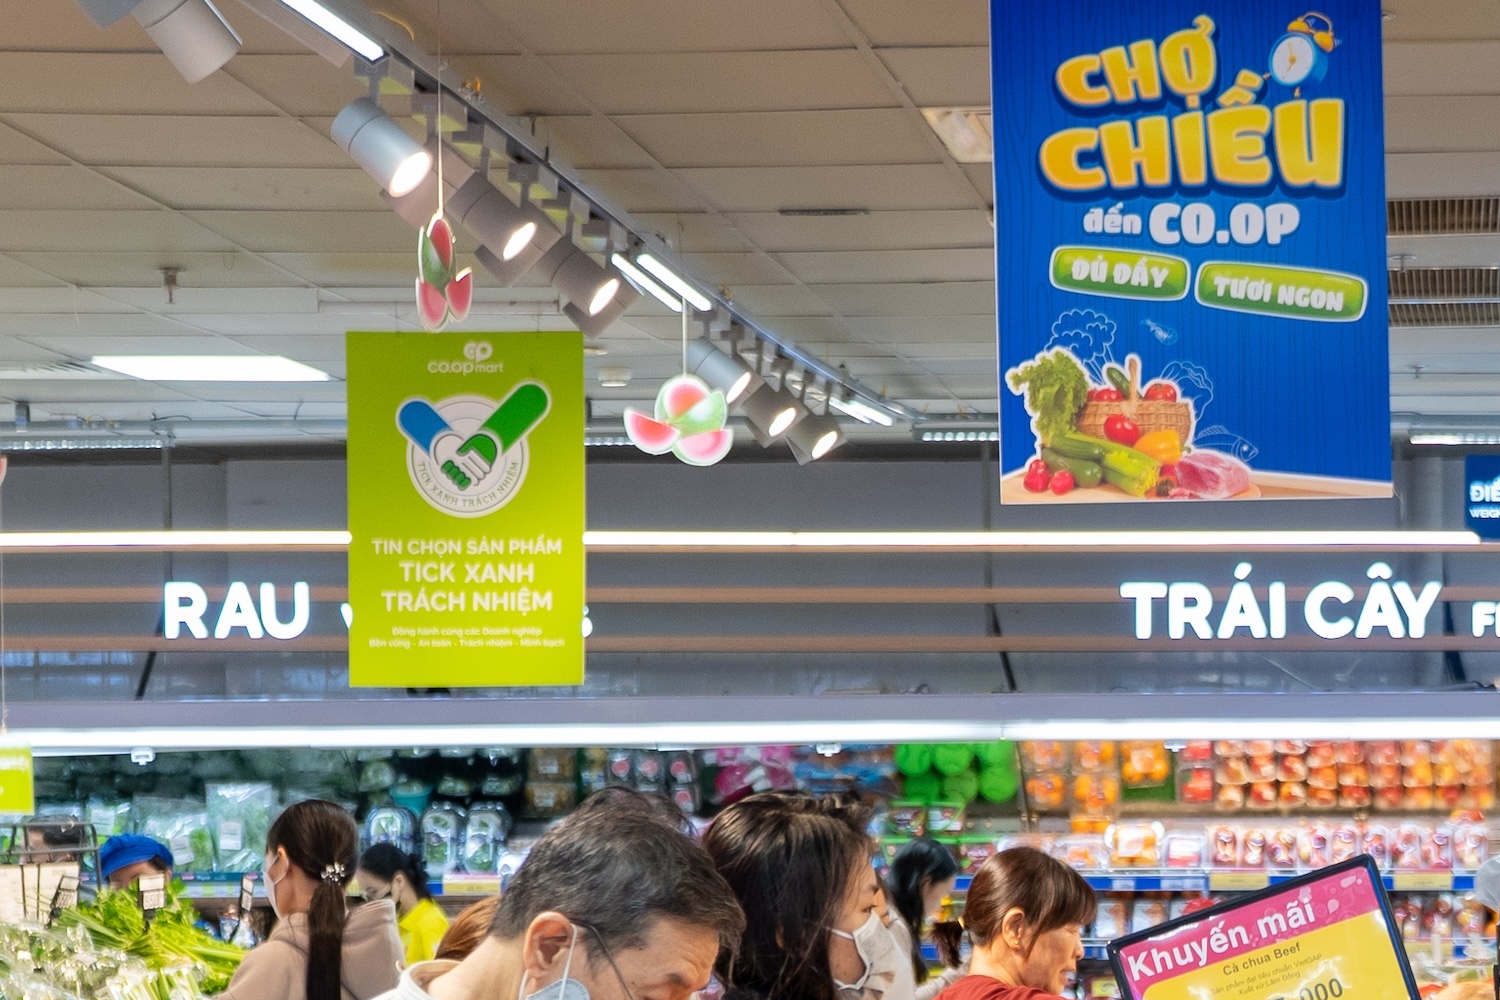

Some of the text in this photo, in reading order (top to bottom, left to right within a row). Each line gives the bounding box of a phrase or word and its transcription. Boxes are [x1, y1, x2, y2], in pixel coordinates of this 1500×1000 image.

[1056, 15, 1216, 108] CHỢ
[1040, 69, 1344, 189] CHIỀU
[1083, 203, 1300, 246] đến CO.OP
[1072, 254, 1107, 283] ĐỦ
[1214, 276, 1344, 312] TƯƠI NGON
[371, 538, 402, 555] TIN
[408, 538, 462, 558] CHỌN
[509, 533, 562, 555] PHẨM
[399, 562, 534, 584] TICK XANH
[164, 581, 310, 640] RAU
[381, 587, 552, 616] TRÁCH NHIỆM
[1119, 562, 1286, 640] TRÁI
[1304, 562, 1441, 640] CÂY
[1127, 897, 1316, 981] Khuyến mãi
[1222, 942, 1301, 976] Cà chua Beef
